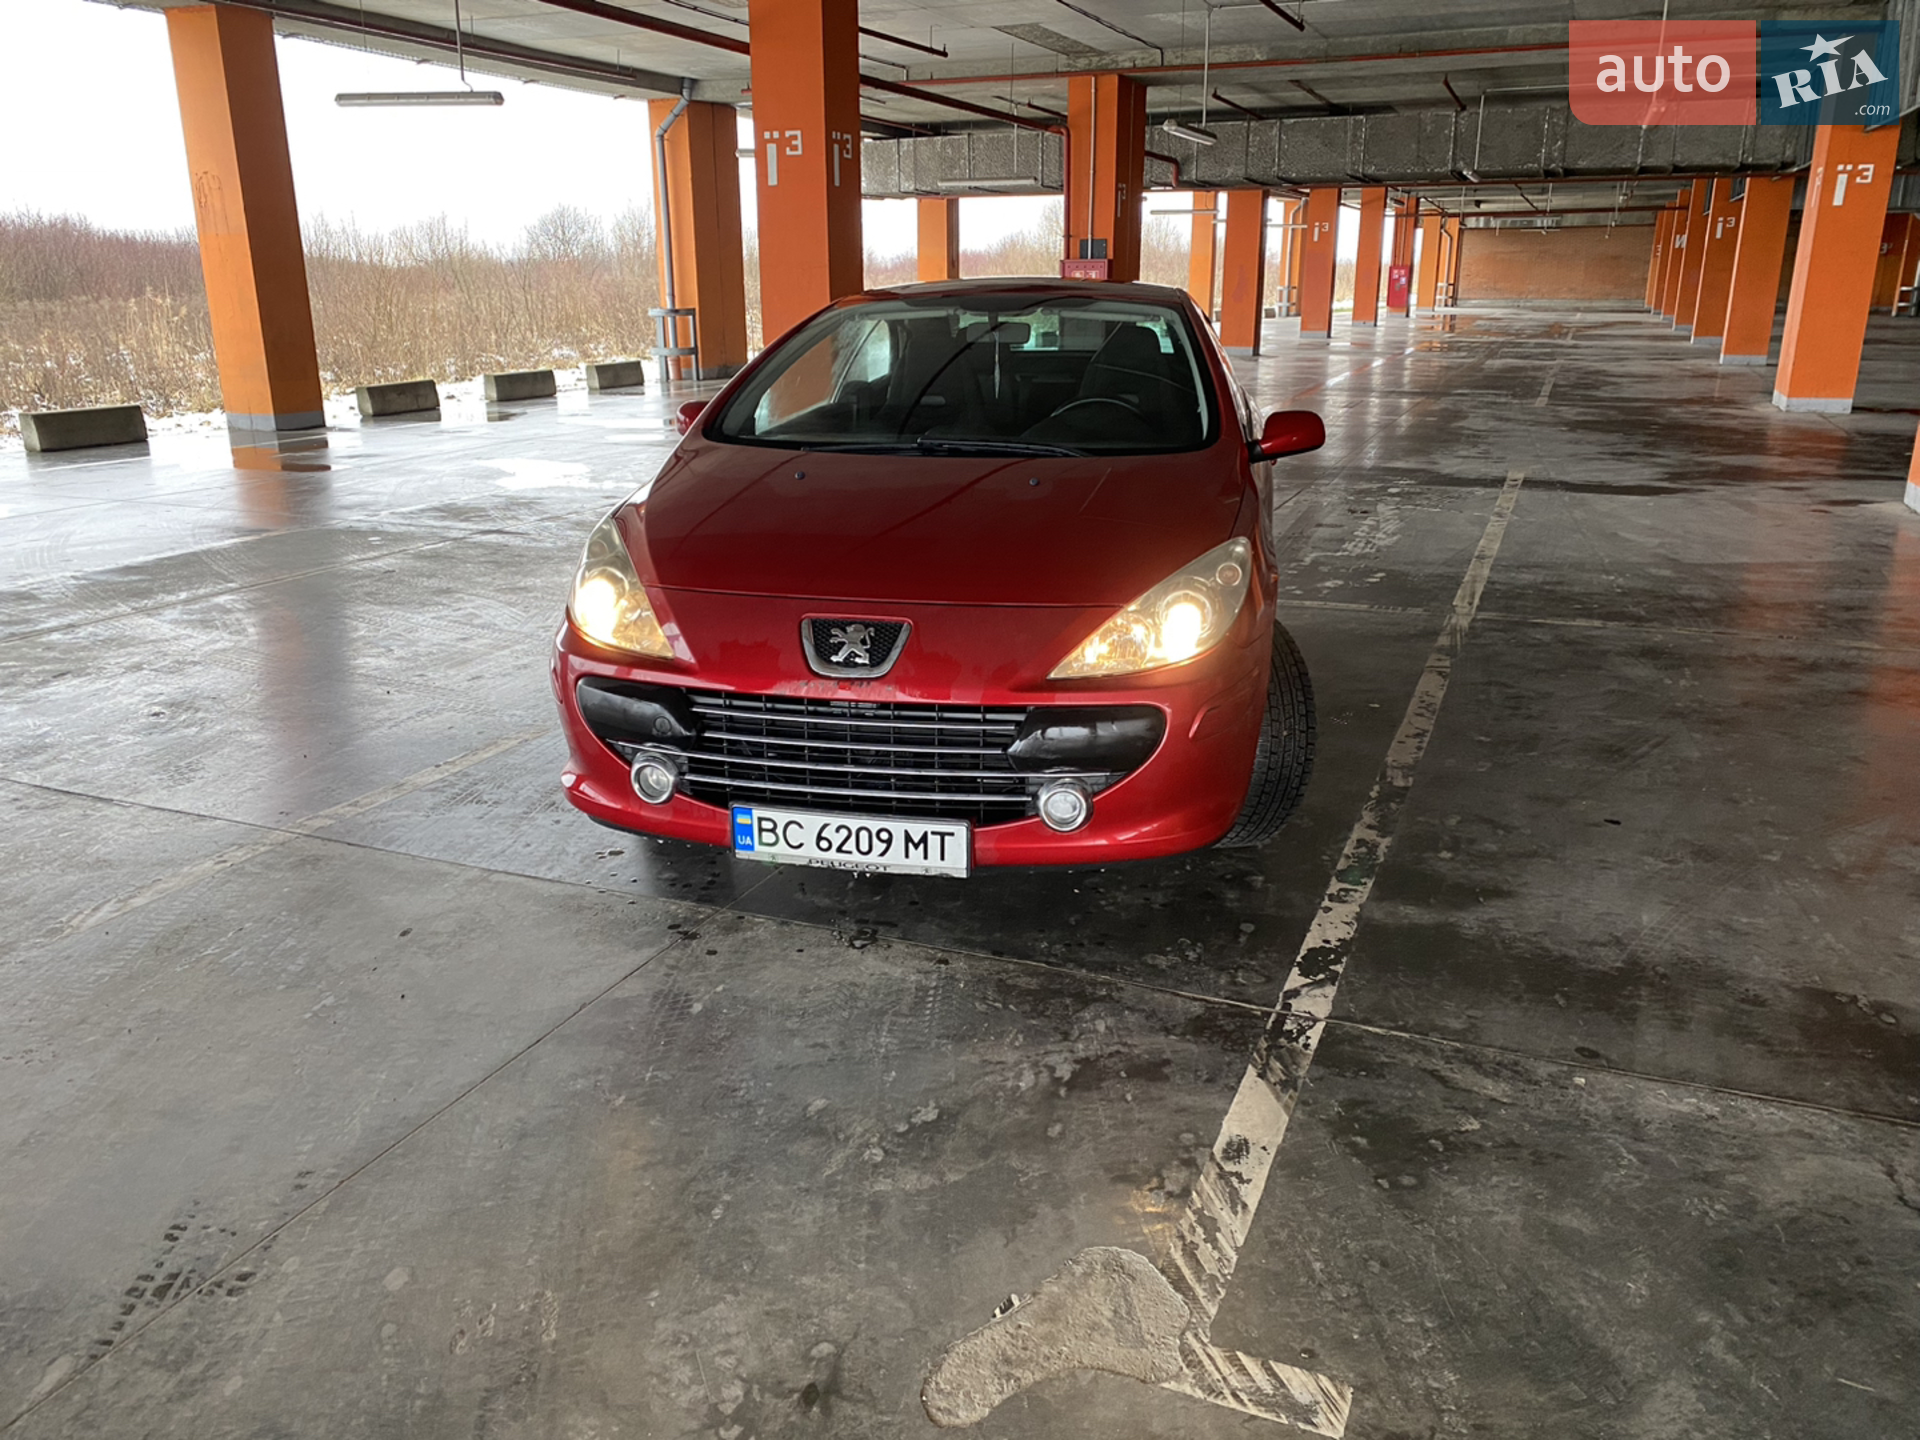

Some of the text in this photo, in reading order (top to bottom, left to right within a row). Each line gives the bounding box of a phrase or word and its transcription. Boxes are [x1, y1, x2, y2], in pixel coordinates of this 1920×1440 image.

[738, 835, 753, 846] UA
[757, 816, 955, 861] BC 6209 MT
